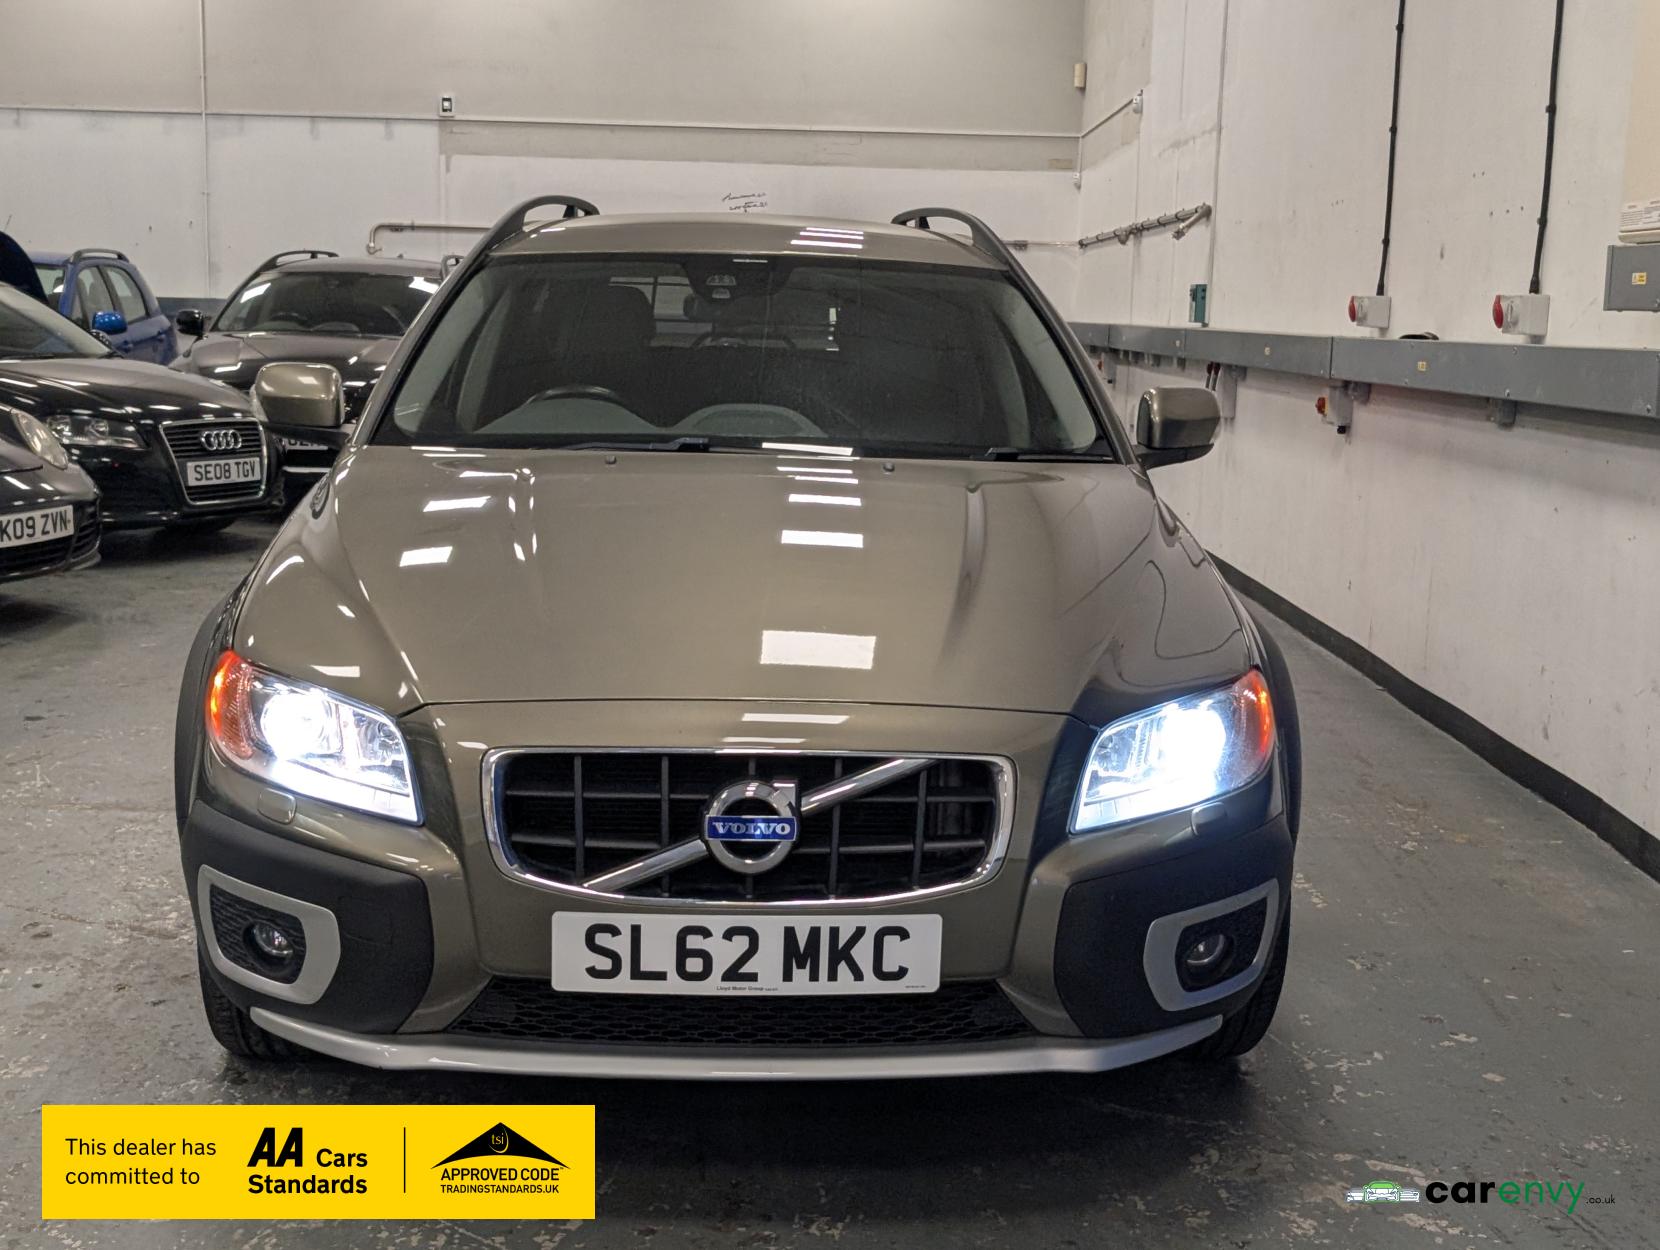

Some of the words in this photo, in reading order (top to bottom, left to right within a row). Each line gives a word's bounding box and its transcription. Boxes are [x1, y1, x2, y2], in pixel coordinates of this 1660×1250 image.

[194, 462, 232, 481] SE08
[234, 460, 256, 478] TGV
[40, 510, 68, 536] ZVN
[712, 822, 792, 836] VOLVO
[584, 922, 760, 983] SL62
[782, 925, 911, 983] MKC
